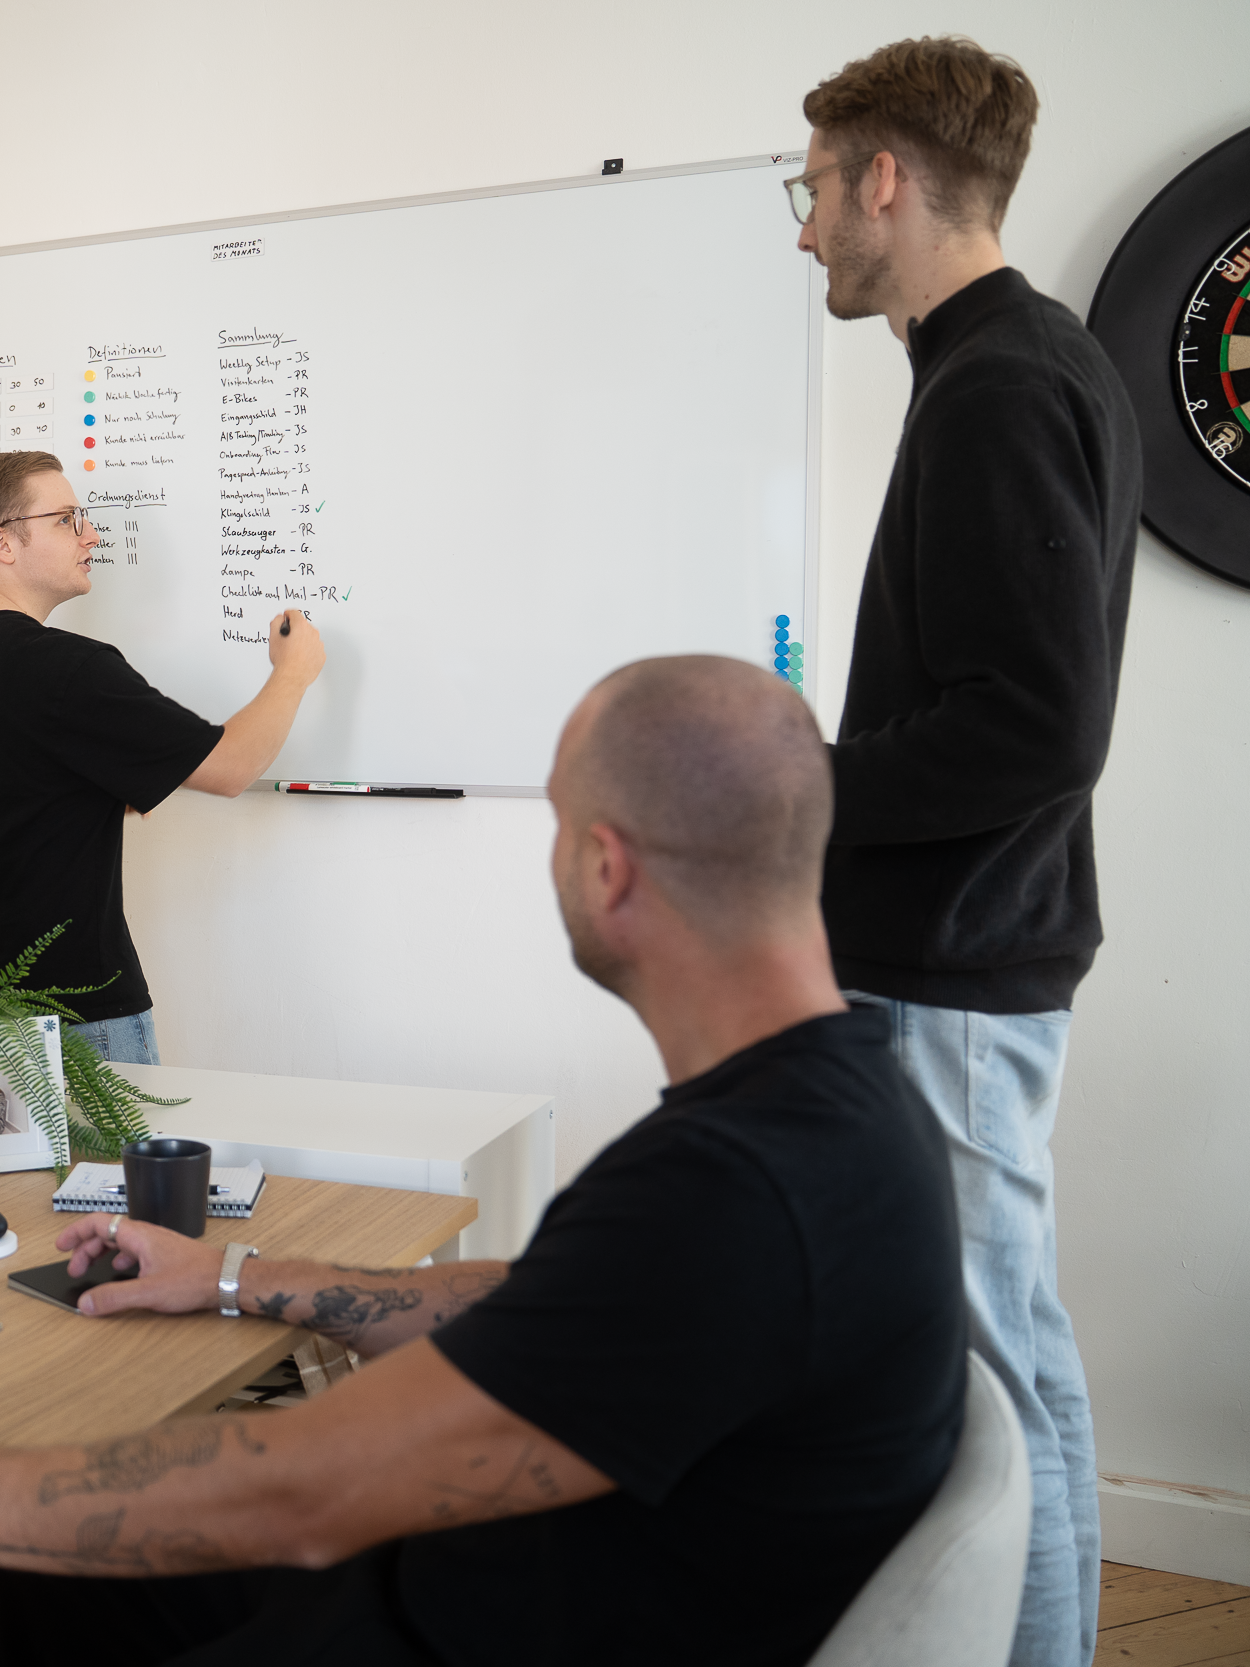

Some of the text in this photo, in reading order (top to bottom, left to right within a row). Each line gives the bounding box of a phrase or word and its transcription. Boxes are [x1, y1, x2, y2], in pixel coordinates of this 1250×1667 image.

[213, 248, 261, 260] DES MONATS
[218, 326, 284, 348] Sammlung
[87, 343, 163, 360] Definitionen
[220, 358, 252, 375] Weekly
[255, 355, 281, 371] Setup
[295, 351, 310, 363] JS
[104, 365, 141, 380] Pausiert
[220, 376, 274, 387] Visitenkarten
[294, 369, 309, 380] PR
[34, 377, 45, 386] 50
[157, 388, 182, 403] fertig
[222, 393, 258, 405] E-Bikes
[293, 387, 309, 398] PR
[1186, 399, 1208, 412] 8
[104, 410, 181, 425] Nur noch Schulung
[220, 407, 277, 426] Eingangsschild
[293, 404, 307, 416] JH
[10, 427, 21, 436] 30
[37, 425, 48, 433] 40
[294, 424, 307, 436] JS
[104, 435, 127, 445] Kunde
[150, 431, 186, 441] erreichbar
[104, 460, 127, 468] Kunde
[151, 455, 174, 465] liefern
[219, 450, 264, 465] Onboarding
[262, 445, 280, 456] Flow
[301, 483, 309, 494] A
[88, 487, 166, 509] Ordnungsdienst
[220, 508, 271, 523] Klingelschild
[221, 526, 276, 542] Staubsauger
[298, 522, 315, 537] PR
[221, 544, 286, 561] Werkzeugkasten
[298, 562, 315, 576] PR
[284, 584, 307, 601] Mail
[319, 586, 339, 603] PR
[223, 605, 243, 619] Herd
